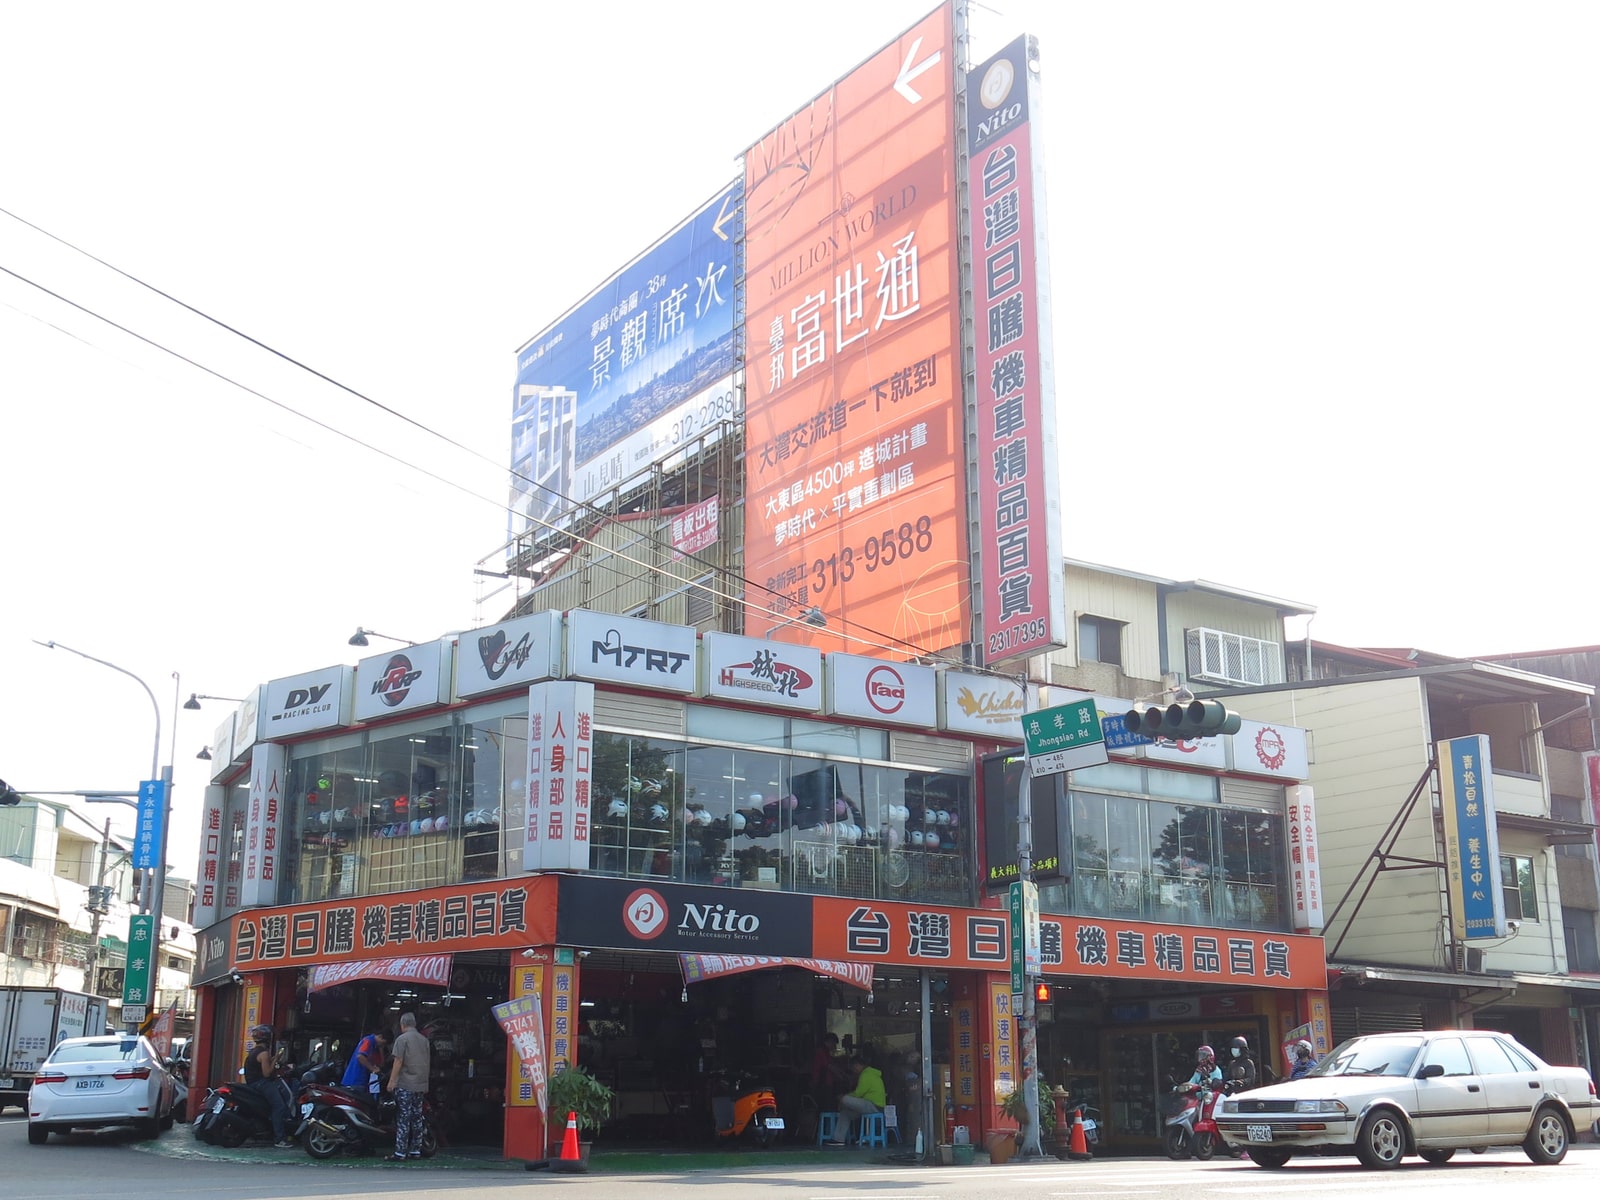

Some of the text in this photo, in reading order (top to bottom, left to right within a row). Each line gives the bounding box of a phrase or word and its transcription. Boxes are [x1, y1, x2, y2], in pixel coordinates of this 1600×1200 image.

[975, 102, 1021, 144] Nito
[769, 184, 917, 295] MILLION WORLD
[791, 231, 921, 379] 富世通
[671, 391, 733, 445] 312-2288
[759, 353, 937, 474] 大灣交流道一下就到
[673, 500, 717, 543] 看板出租
[812, 515, 933, 593] 313-9588
[989, 617, 1046, 655] 2317395
[282, 703, 331, 720] RACING CLUB
[284, 683, 332, 710] DY
[1030, 707, 1091, 736] 忠孝路
[1038, 732, 1074, 747] Jhongsiao
[528, 712, 541, 842] 進口精品
[548, 711, 566, 840] 人身部品
[574, 712, 590, 841] 進口精品
[262, 769, 279, 881] 人身部品
[202, 807, 220, 907] 進口精品
[362, 886, 528, 950] 機車精品百貨
[678, 903, 760, 933] Nito
[678, 929, 696, 937] Motor
[700, 931, 731, 939] Accessory
[128, 928, 147, 1001] 忠孝路
[208, 936, 224, 961] Nito
[1076, 925, 1291, 980] 機車精品百貨
[504, 1015, 533, 1034] 2T/4T
[14, 1062, 34, 1071] 7731
